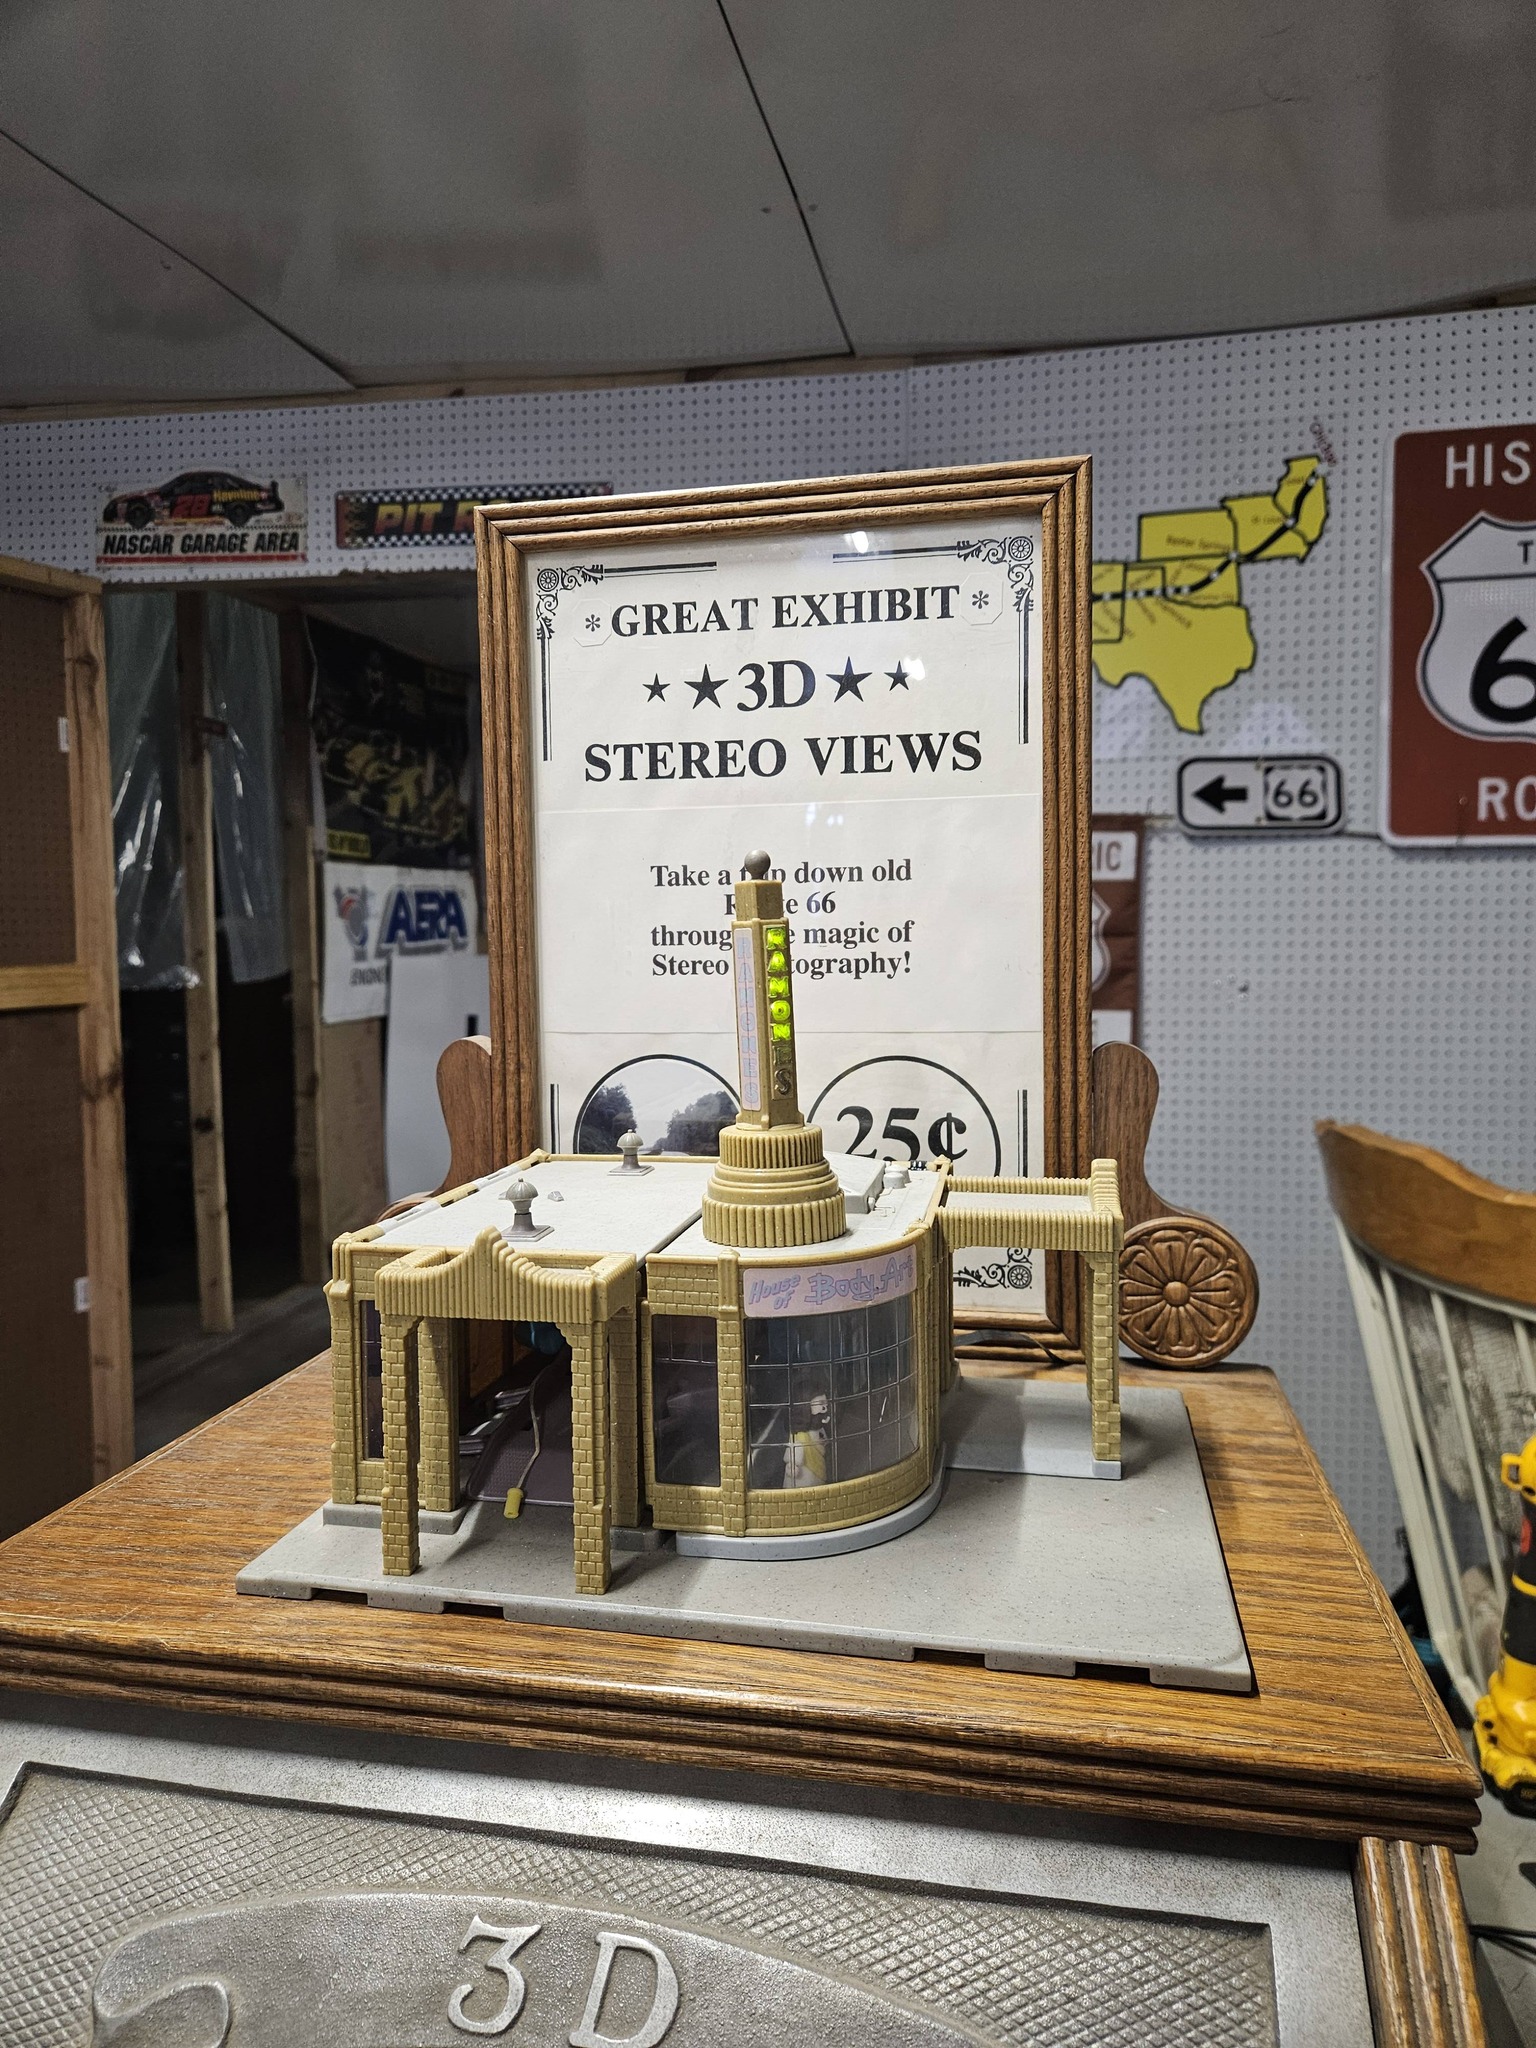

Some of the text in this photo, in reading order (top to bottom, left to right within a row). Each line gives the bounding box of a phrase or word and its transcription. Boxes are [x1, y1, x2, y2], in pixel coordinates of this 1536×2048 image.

[374, 502, 444, 534] PIT
[103, 531, 300, 555] NASCAR GARAGE AREA
[612, 586, 959, 636] GREAT EXHIBIT
[737, 660, 815, 711] 3D
[585, 731, 981, 781] STEREO VIEWS
[1273, 778, 1319, 810] 66
[651, 865, 709, 886] Take
[717, 869, 732, 886] a
[795, 862, 863, 883] down
[873, 859, 911, 881] old
[806, 891, 836, 914] 66
[651, 925, 733, 951] throug
[804, 921, 879, 949] magic
[888, 920, 914, 942] of
[653, 954, 728, 975] Stereo
[749, 1256, 913, 1305] House Body Art
[774, 1290, 794, 1310] of
